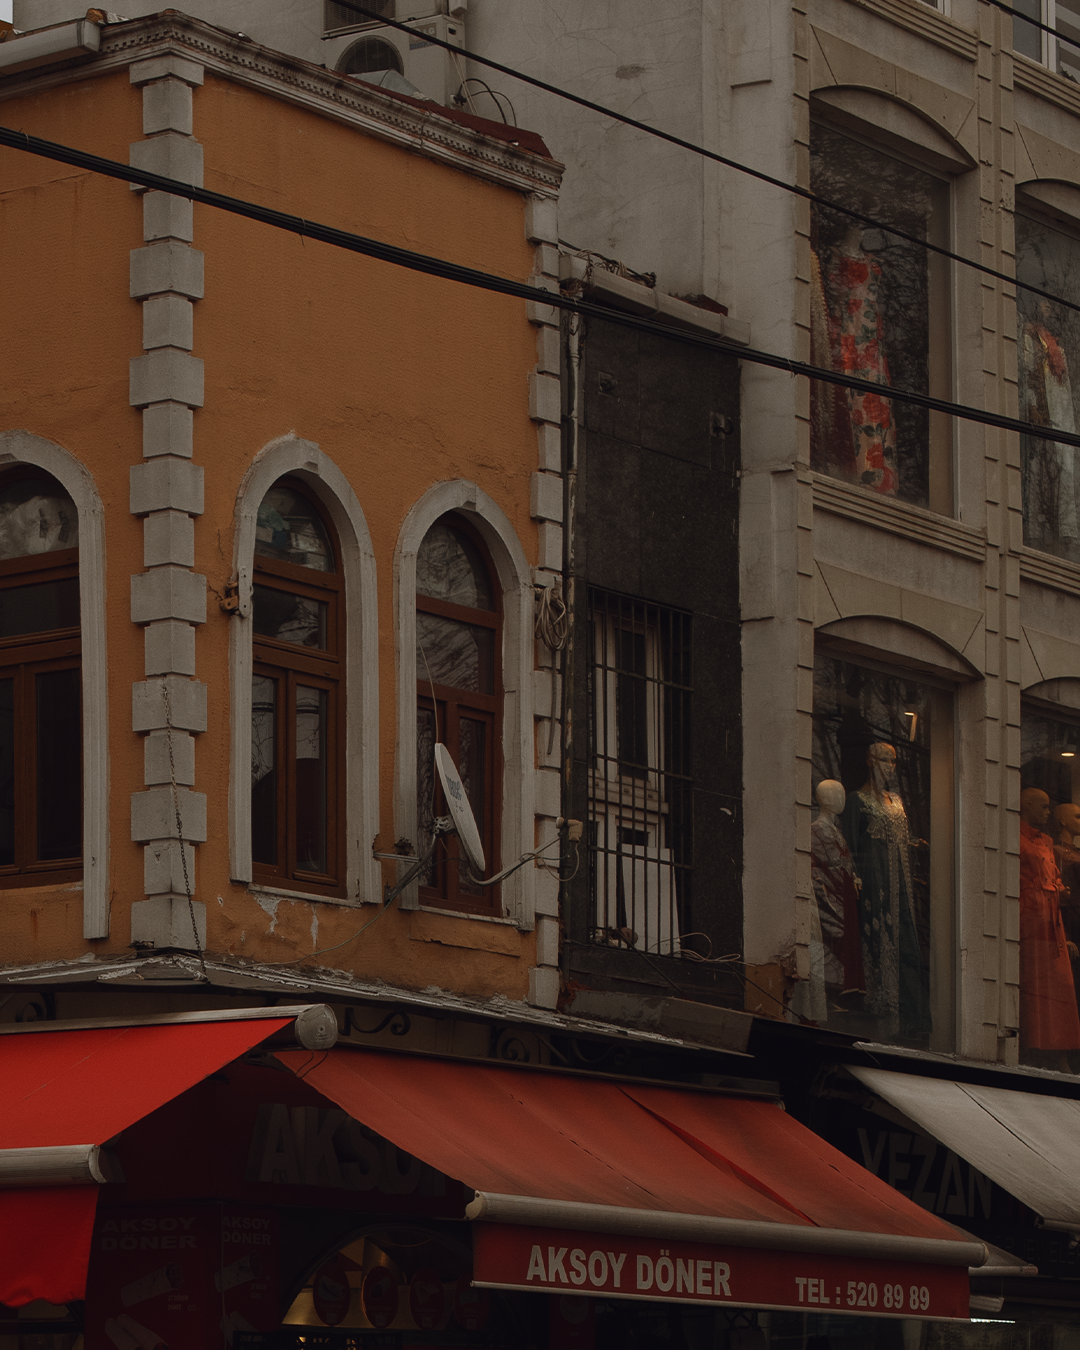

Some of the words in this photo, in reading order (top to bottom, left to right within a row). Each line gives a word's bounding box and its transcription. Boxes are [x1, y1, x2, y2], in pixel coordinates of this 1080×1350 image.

[101, 1217, 197, 1233] AKSOY
[222, 1216, 270, 1230] AKSOY
[101, 1234, 198, 1250] DÖNER
[222, 1229, 271, 1246] DÖNER
[526, 1244, 627, 1288] AKSOY
[636, 1248, 732, 1297] DÖNER
[795, 1276, 830, 1304] TEL
[846, 1280, 878, 1308] 520
[883, 1283, 904, 1309] 89
[909, 1285, 931, 1311] 89
